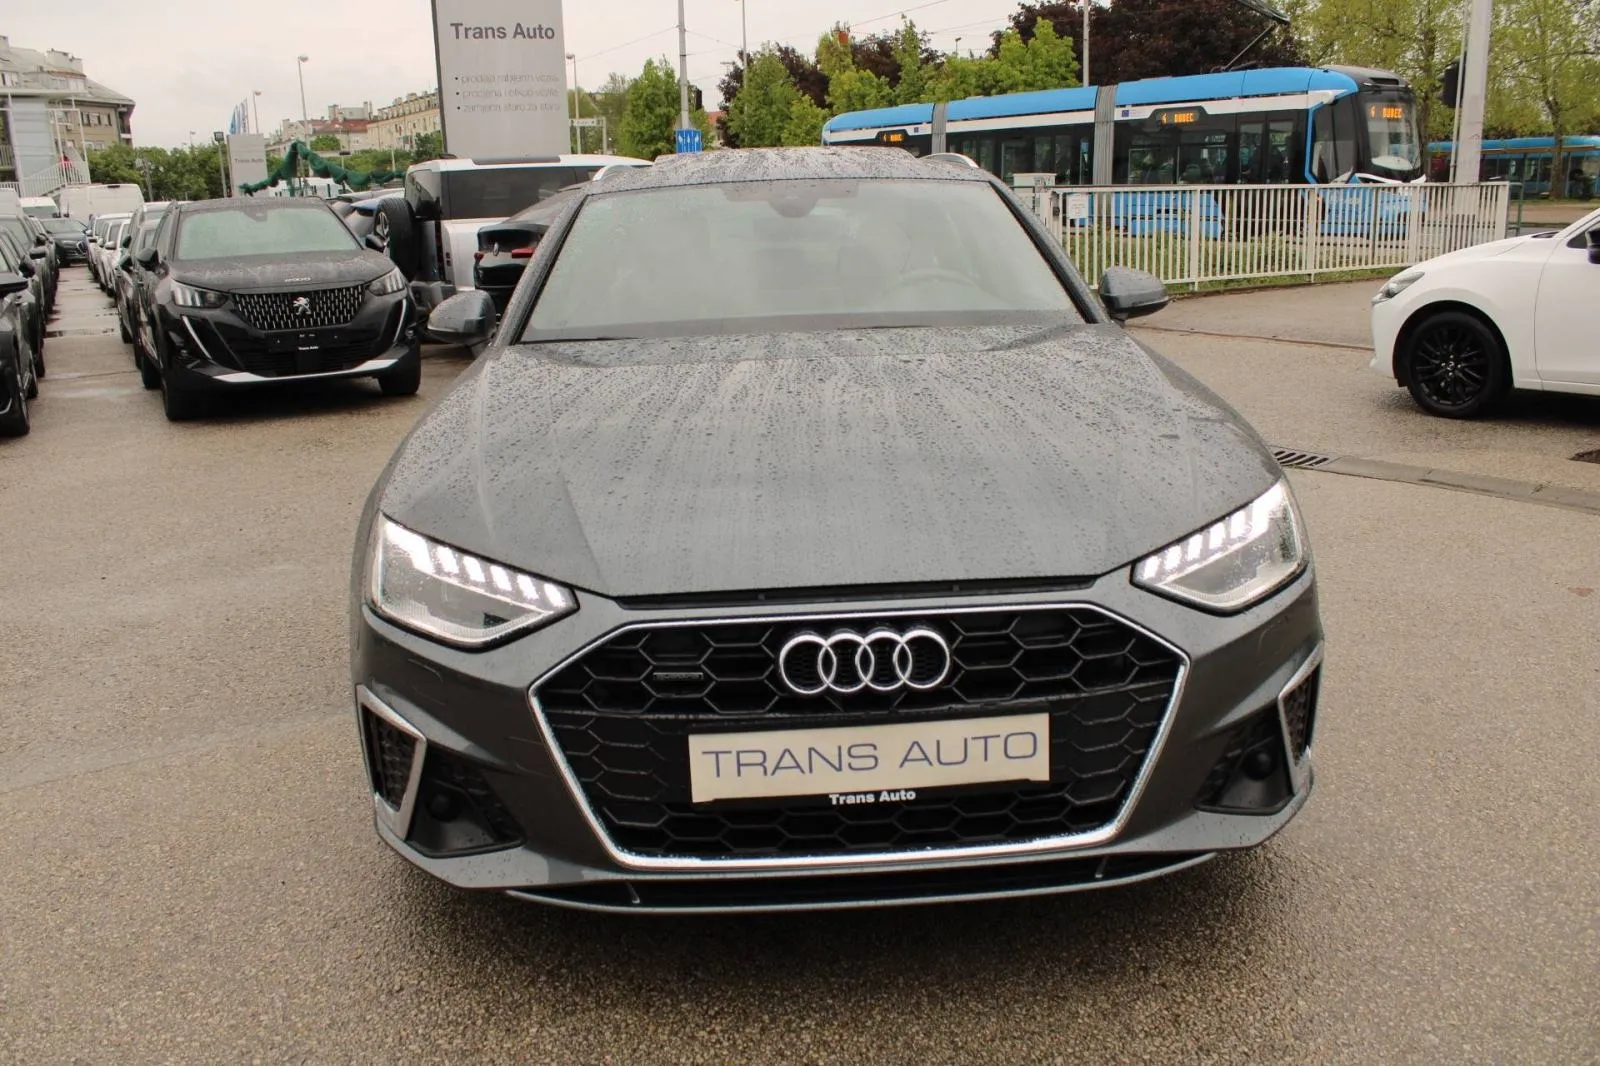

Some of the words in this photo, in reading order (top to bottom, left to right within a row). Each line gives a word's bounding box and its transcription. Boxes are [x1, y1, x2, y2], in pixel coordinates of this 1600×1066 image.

[450, 22, 507, 40] Trans
[512, 22, 556, 40] Auto
[701, 743, 879, 779] TRANS
[899, 731, 1038, 769] AUTO
[828, 793, 876, 806] Trans
[879, 789, 917, 802] Auto
